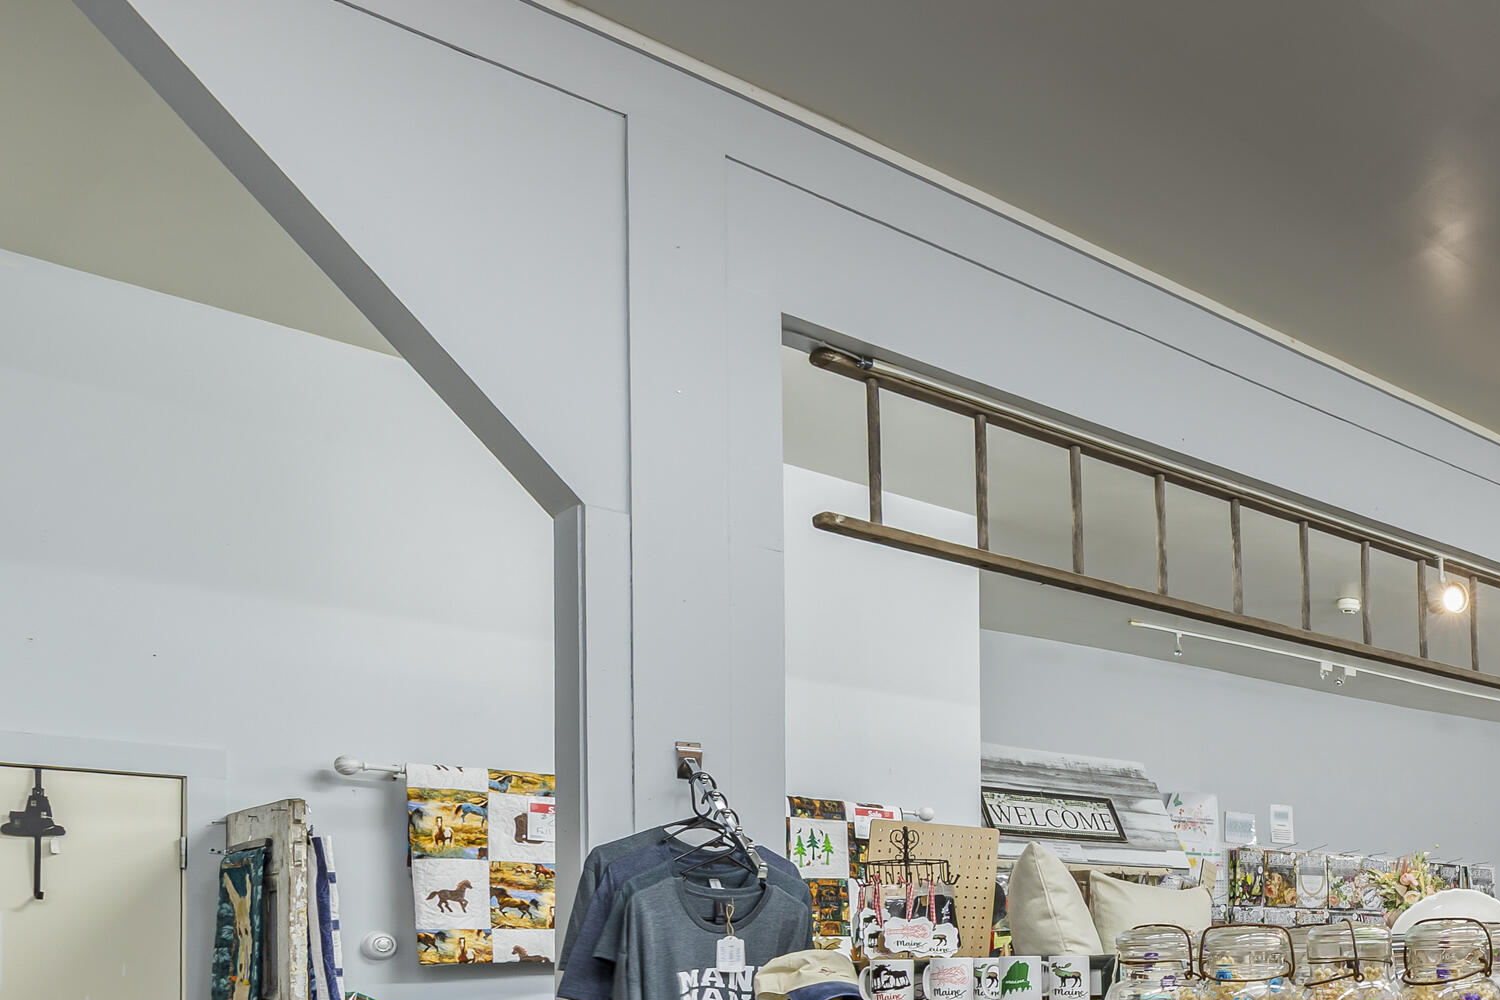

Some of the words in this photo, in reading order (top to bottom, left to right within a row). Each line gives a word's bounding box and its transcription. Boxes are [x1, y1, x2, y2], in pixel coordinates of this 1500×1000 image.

[988, 803, 1117, 832] WELCOME
[933, 986, 966, 1000] Maine
[1053, 987, 1088, 1000] Maine
